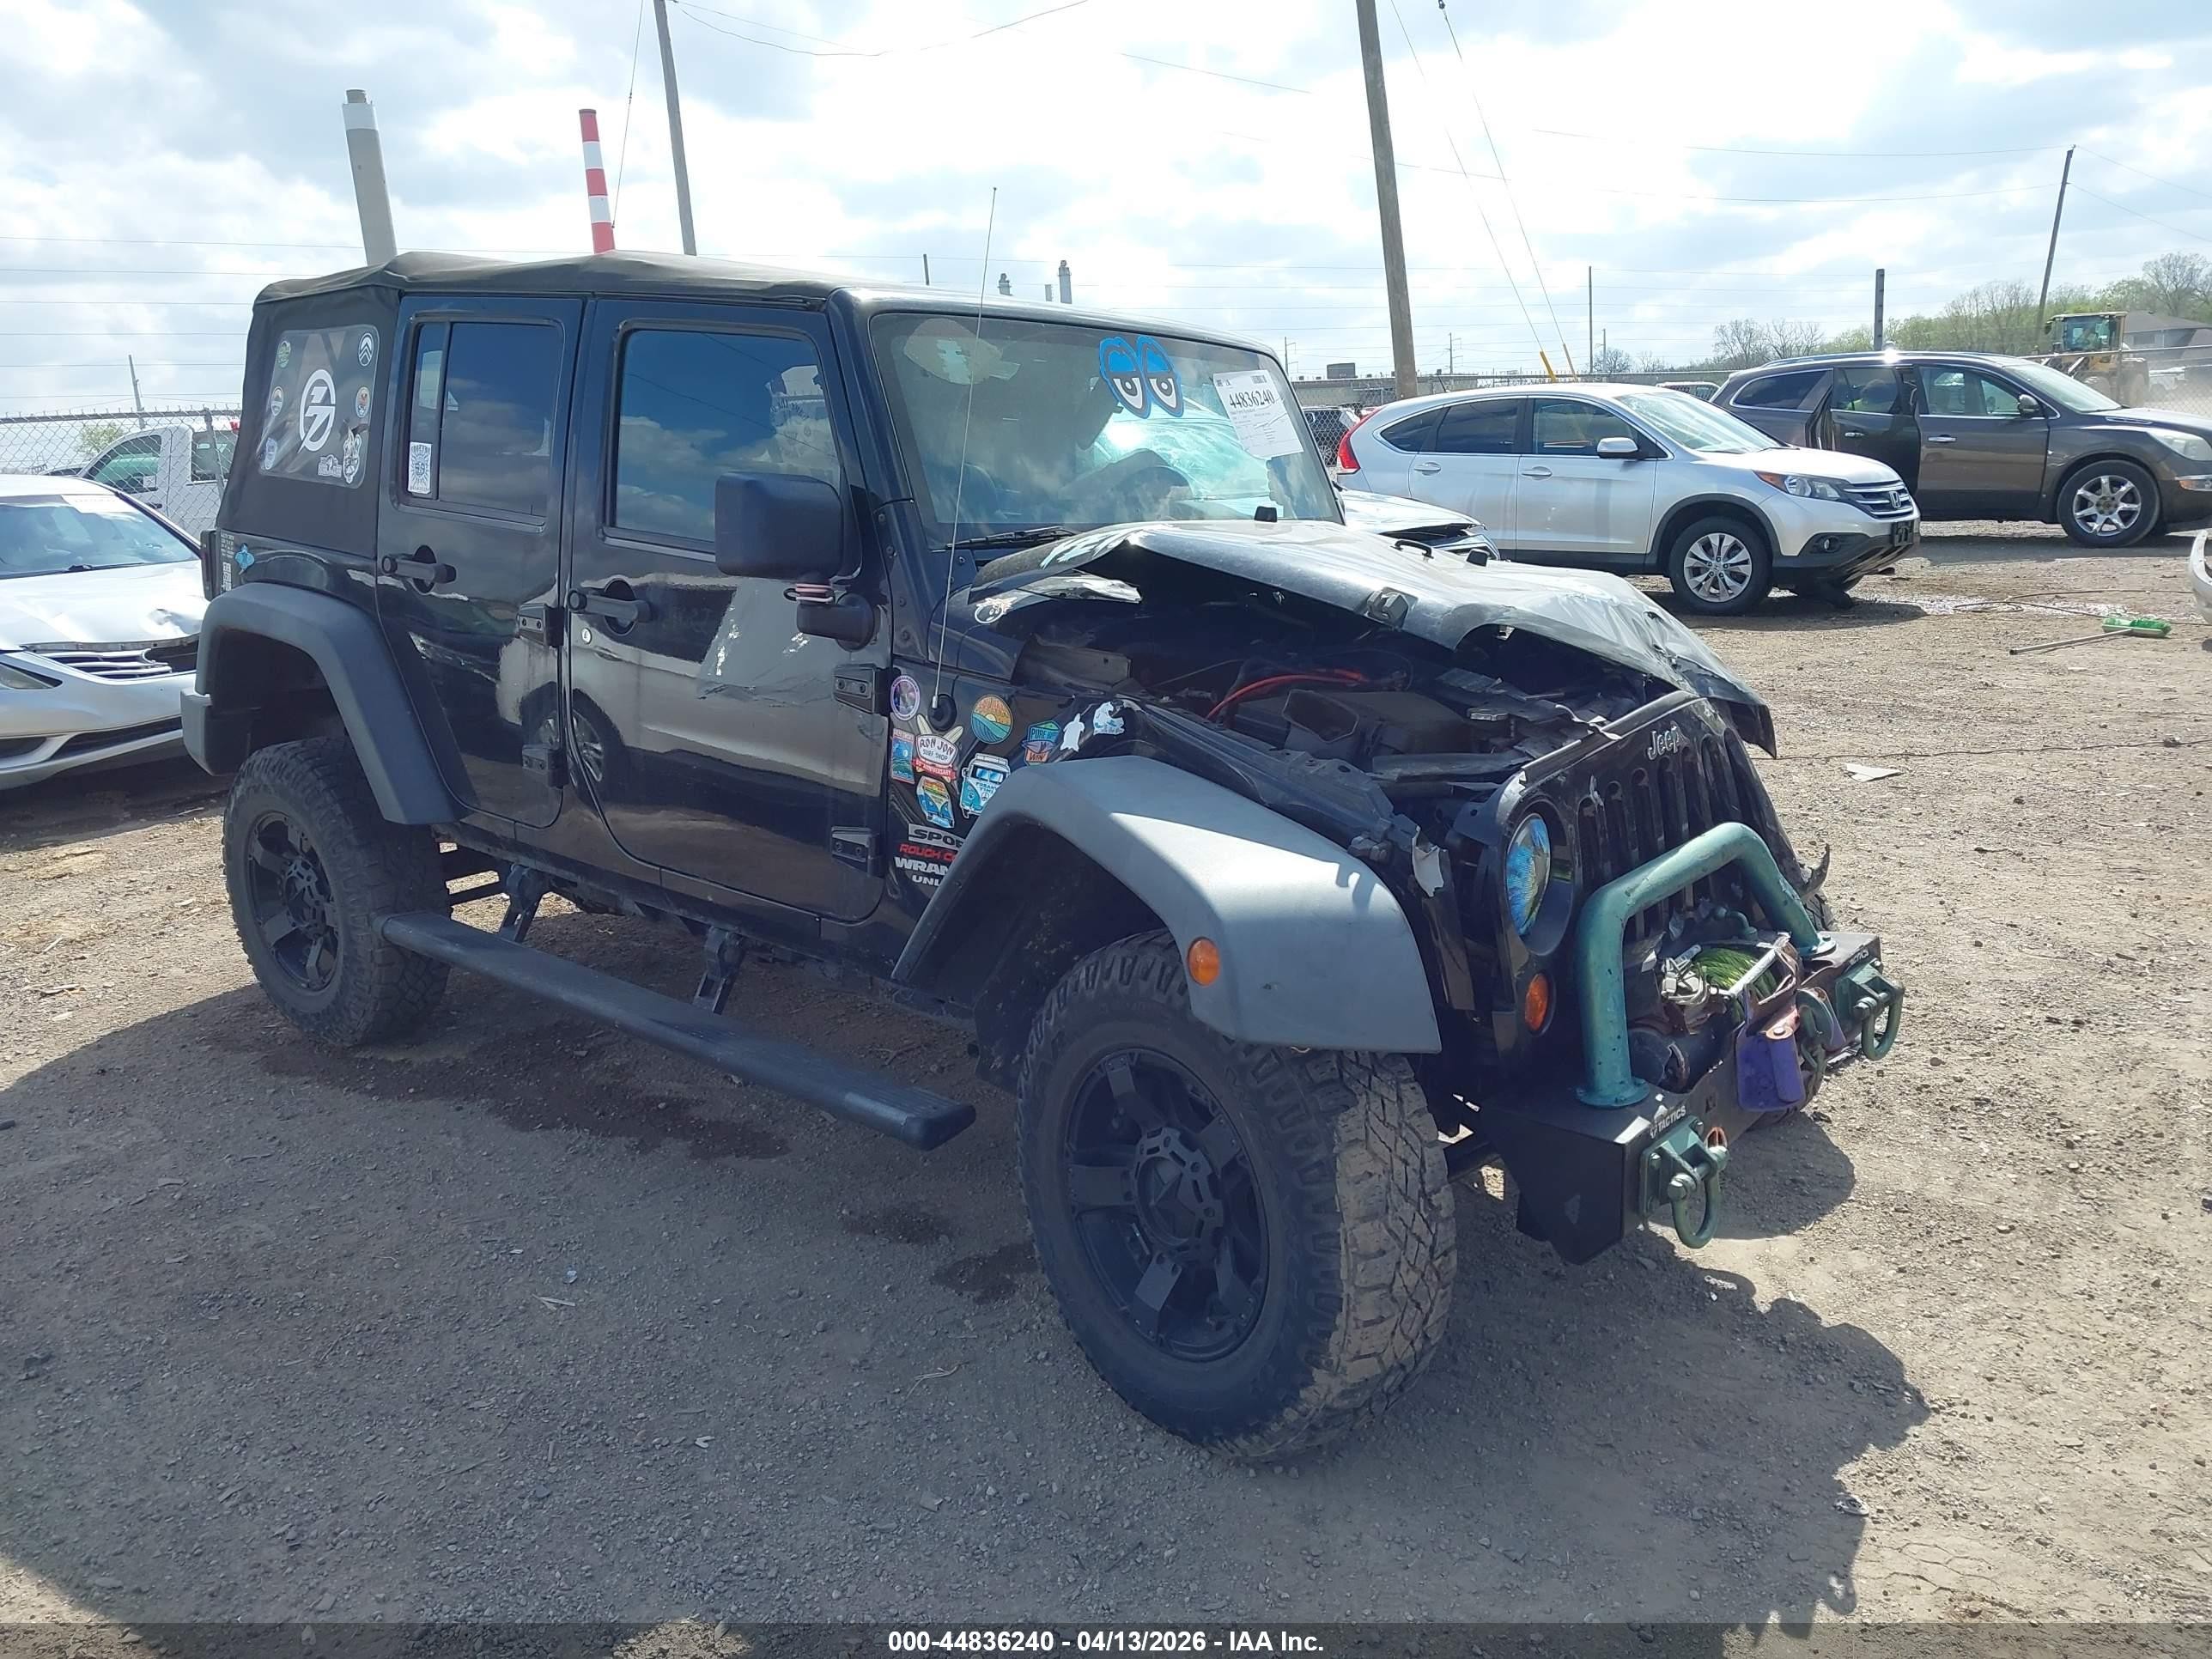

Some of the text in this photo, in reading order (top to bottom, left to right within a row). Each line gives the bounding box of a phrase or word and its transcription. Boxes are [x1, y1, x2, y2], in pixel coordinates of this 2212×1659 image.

[1229, 389, 1275, 409] 44836240
[920, 738, 954, 757] RON JON
[1647, 726, 1680, 762] Jeep
[935, 752, 948, 761] SHOP
[899, 843, 941, 860] ROUGH
[894, 856, 949, 875] WRAN
[912, 874, 942, 887] UNL
[1658, 1105, 1686, 1133] TACTICS
